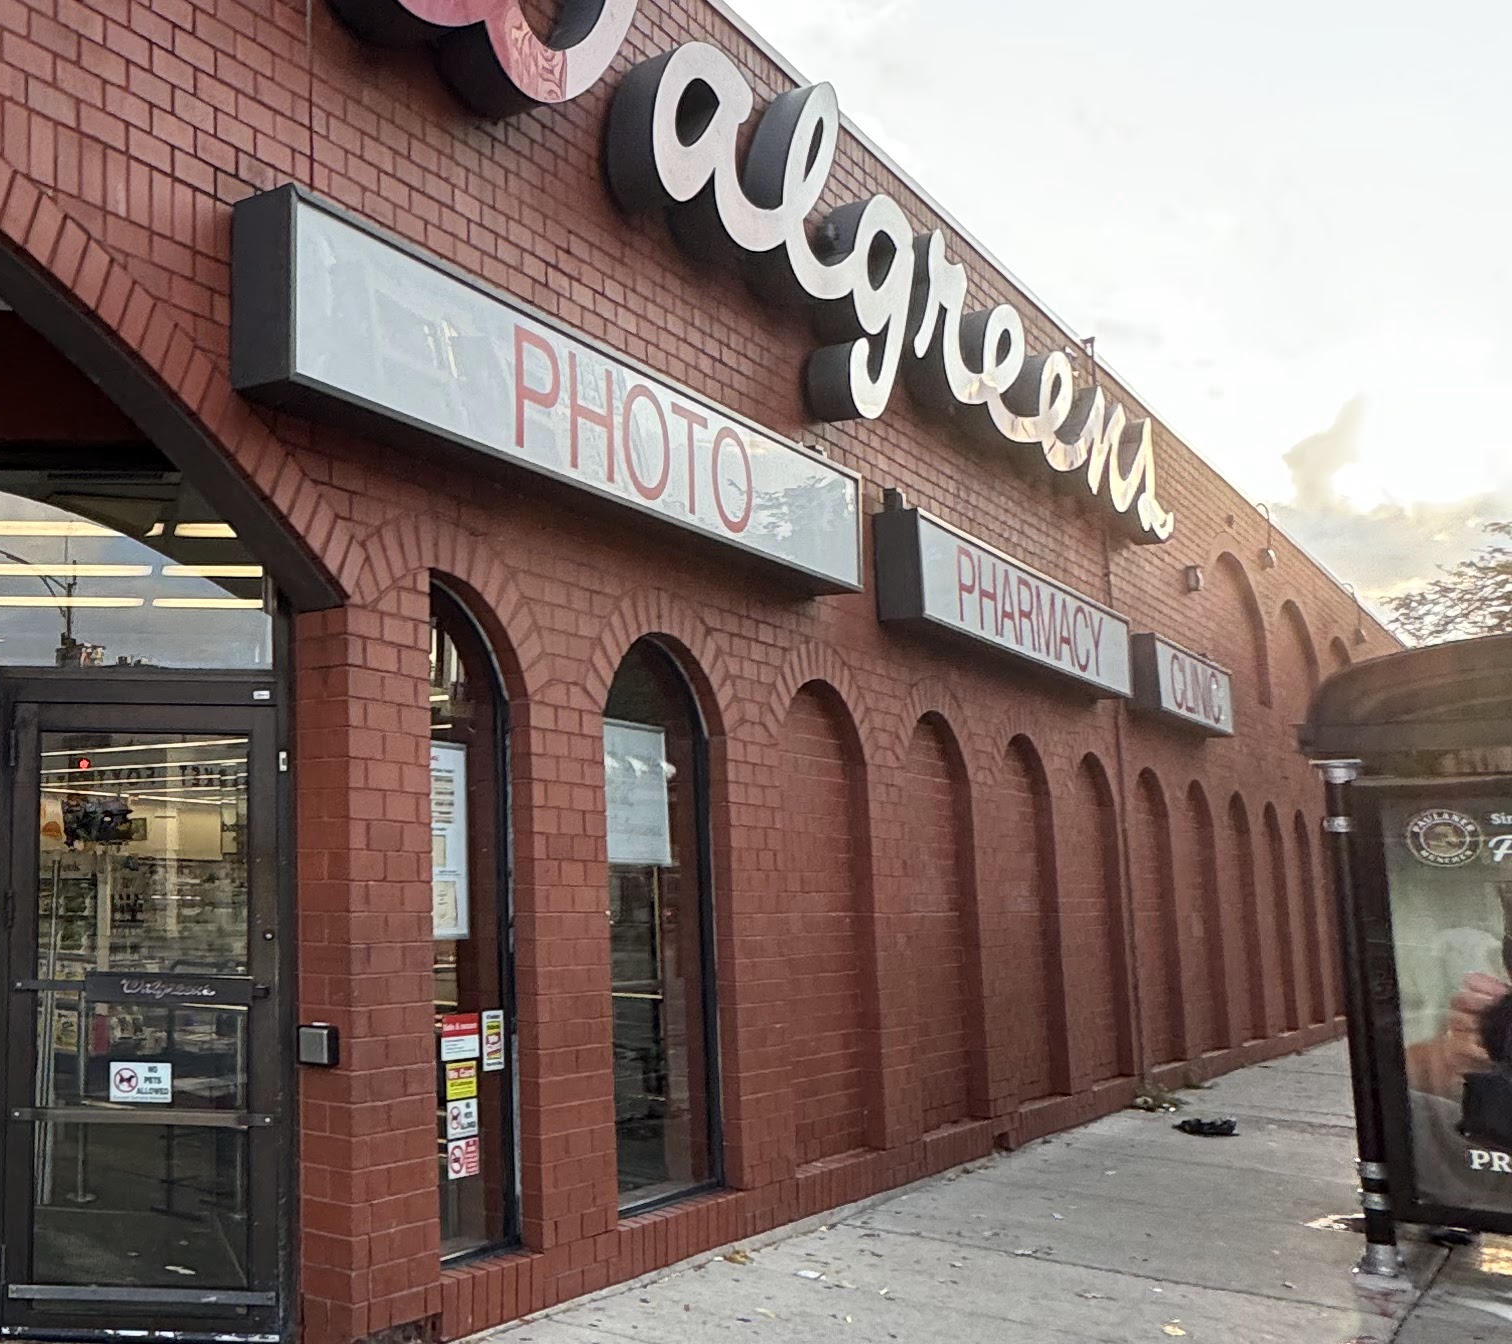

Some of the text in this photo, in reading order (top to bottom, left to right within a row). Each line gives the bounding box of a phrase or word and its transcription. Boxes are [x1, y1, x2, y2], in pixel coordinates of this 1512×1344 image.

[514, 324, 754, 534] PHOTO
[955, 545, 1104, 678] PHARMACY
[136, 1087, 169, 1095] ALLOWED
[144, 1076, 163, 1084] PETS
